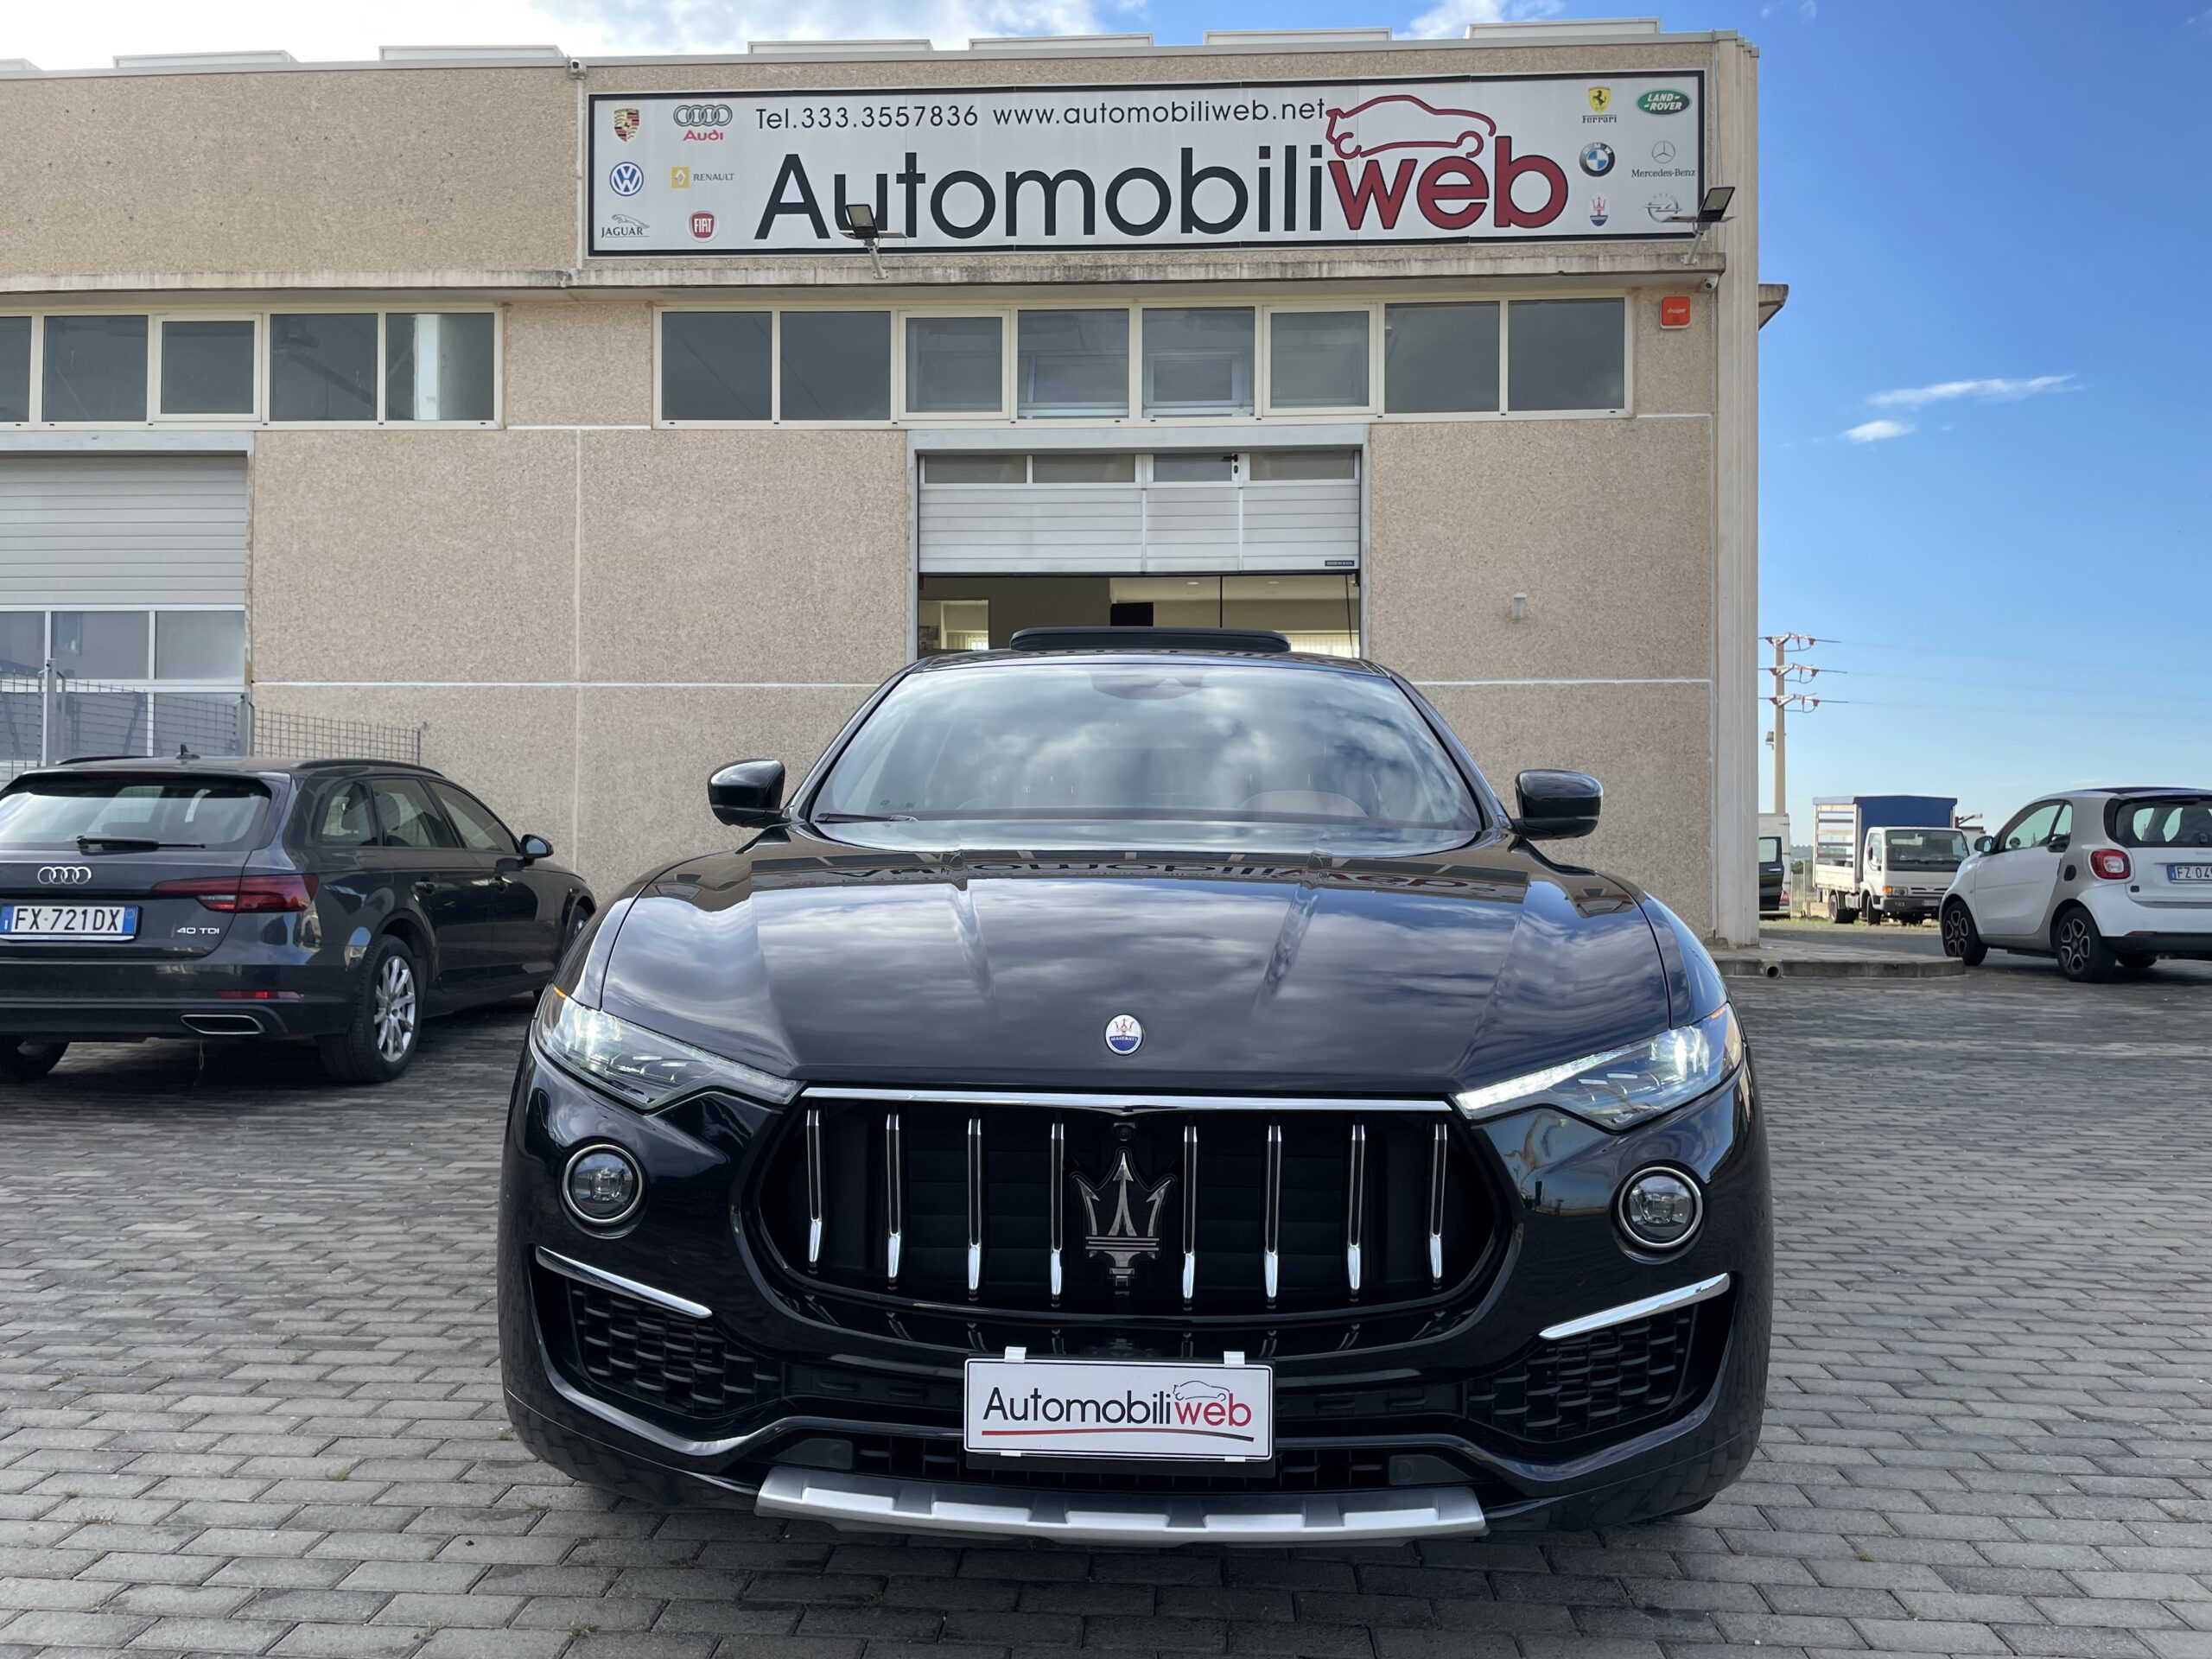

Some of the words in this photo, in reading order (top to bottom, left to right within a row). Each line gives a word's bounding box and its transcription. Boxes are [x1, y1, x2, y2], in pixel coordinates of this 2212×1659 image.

[755, 105, 978, 130] Tel.333.3557836
[993, 98, 1325, 125] www.automobiliweb.net
[1581, 114, 1617, 124] Ferrari
[683, 130, 723, 141] Audi
[693, 173, 734, 181] RENAULT
[1631, 168, 1695, 178] Mercedes-Benz
[694, 218, 713, 233] FIAT
[601, 226, 643, 238] JAGUAR
